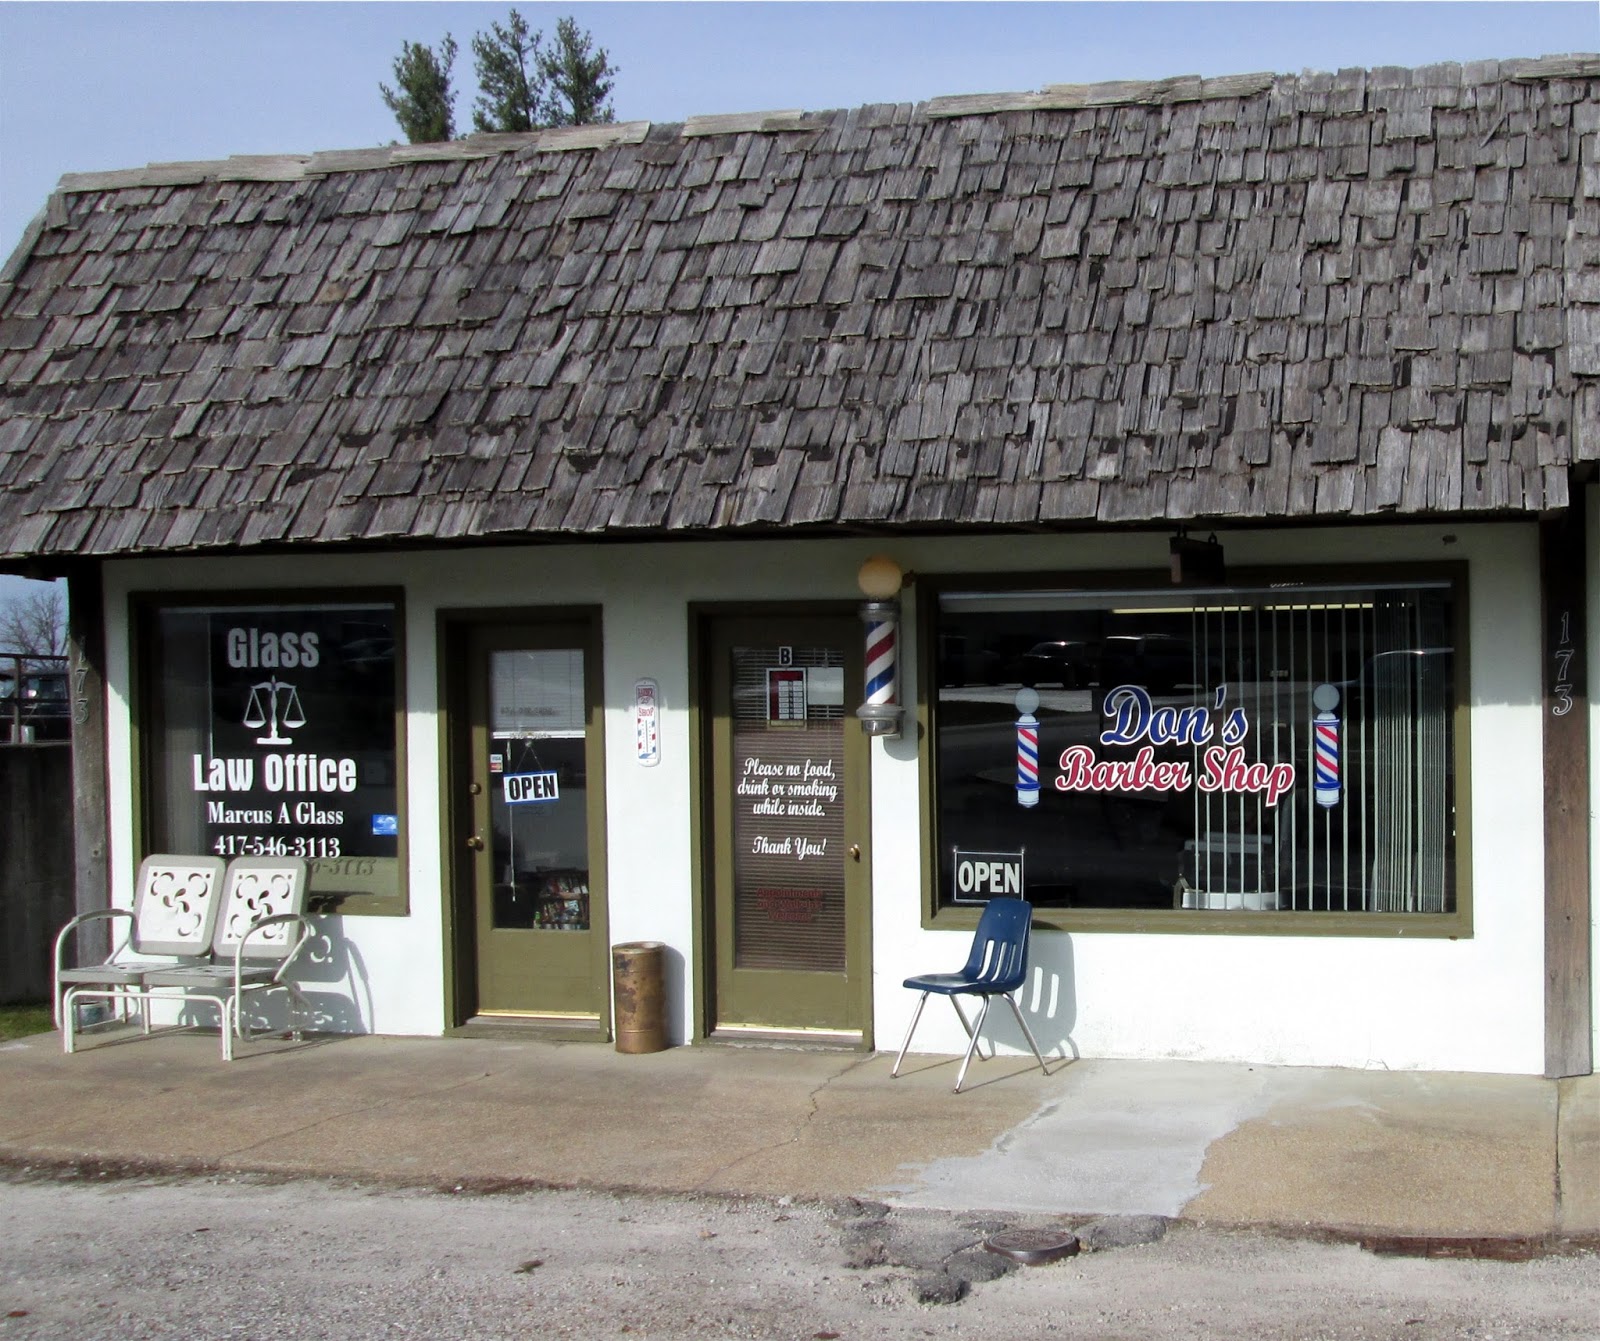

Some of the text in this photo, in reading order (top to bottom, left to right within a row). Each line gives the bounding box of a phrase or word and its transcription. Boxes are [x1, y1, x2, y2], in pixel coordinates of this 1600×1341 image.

[227, 627, 320, 668] Glass
[780, 647, 791, 664] B
[1552, 611, 1574, 716] 173
[1100, 684, 1249, 745] Don's
[193, 754, 357, 792] Law Office
[743, 757, 836, 781] Please no food,
[1055, 745, 1295, 807] Barber Shop
[507, 774, 557, 801] OPEN
[737, 777, 838, 802] drink or smoking
[207, 801, 344, 825] Marcus A Glass
[752, 797, 826, 816] while inside.
[214, 834, 342, 858] 417-546-3113
[751, 835, 827, 861] Thank You!
[957, 860, 1020, 894] OPEN
